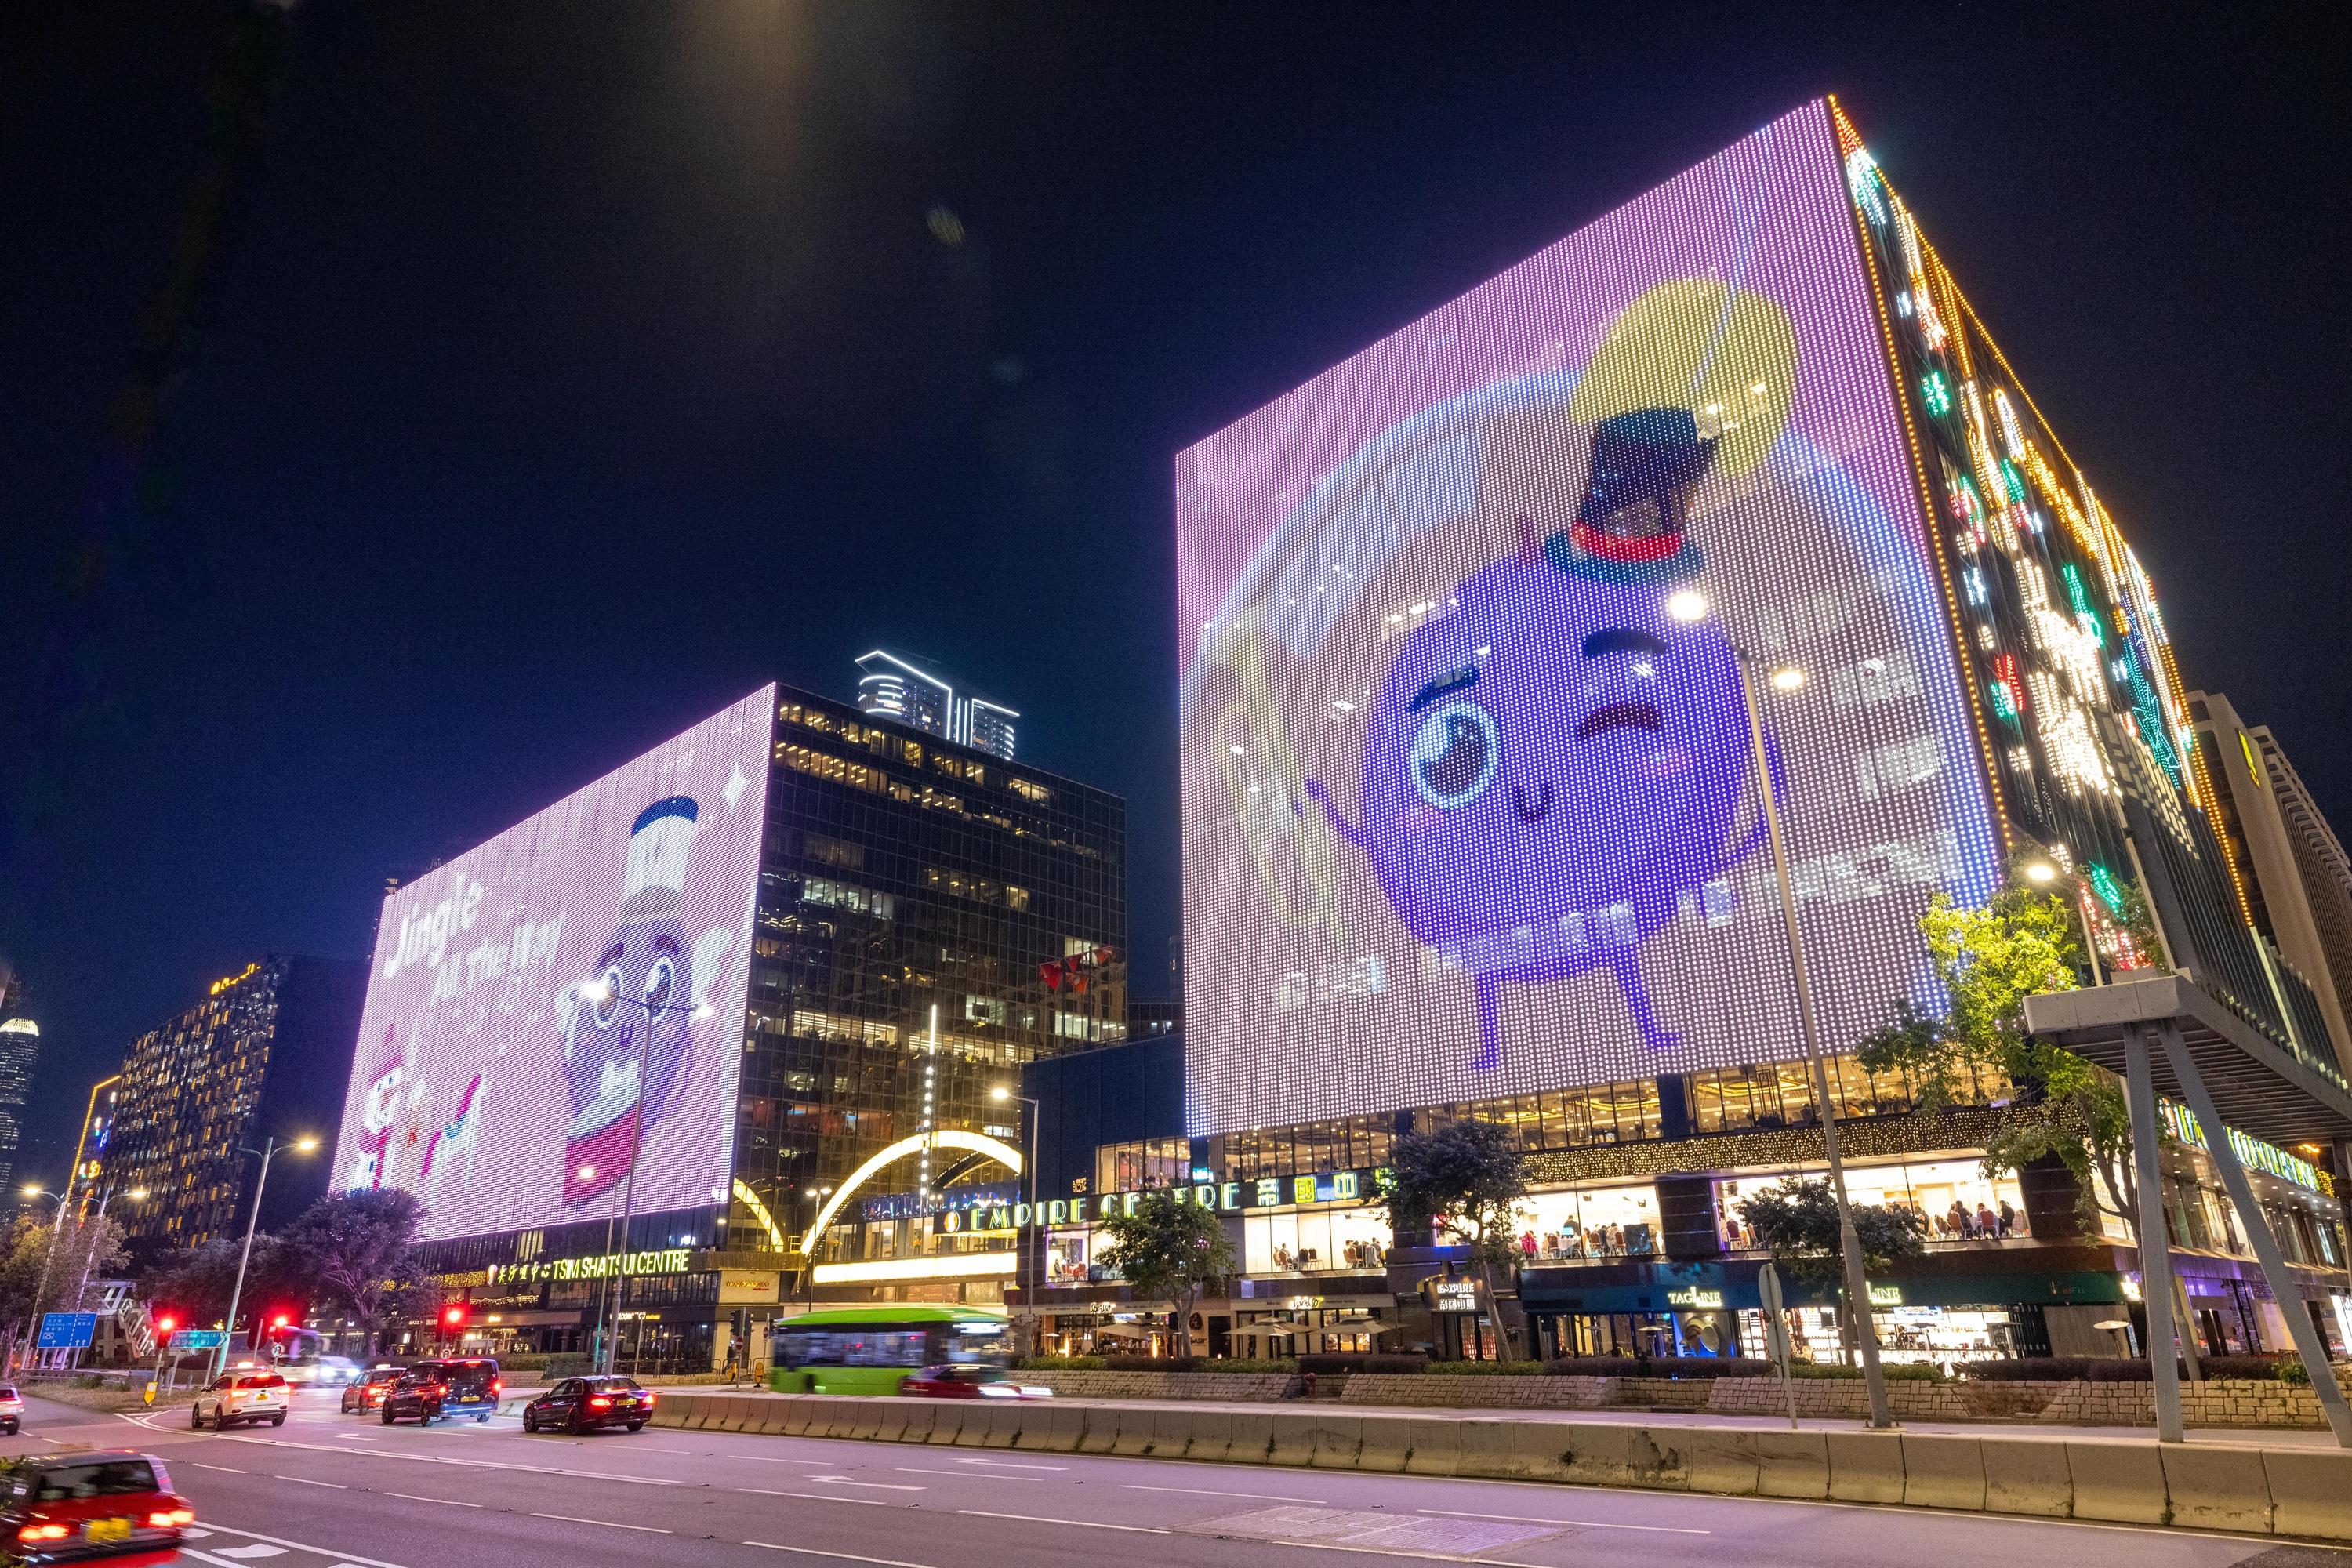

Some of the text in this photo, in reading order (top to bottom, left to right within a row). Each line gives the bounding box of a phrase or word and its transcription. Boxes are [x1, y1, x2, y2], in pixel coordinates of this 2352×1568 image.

[383, 872, 483, 979] Jingle
[971, 1197, 1087, 1230] EMPIRE
[1100, 1182, 1240, 1218] CETRE
[553, 1259, 579, 1279] TSIM
[581, 1256, 606, 1278] SHA
[637, 1250, 690, 1274] CENTRE
[1668, 1287, 1721, 1304] TAGLINE
